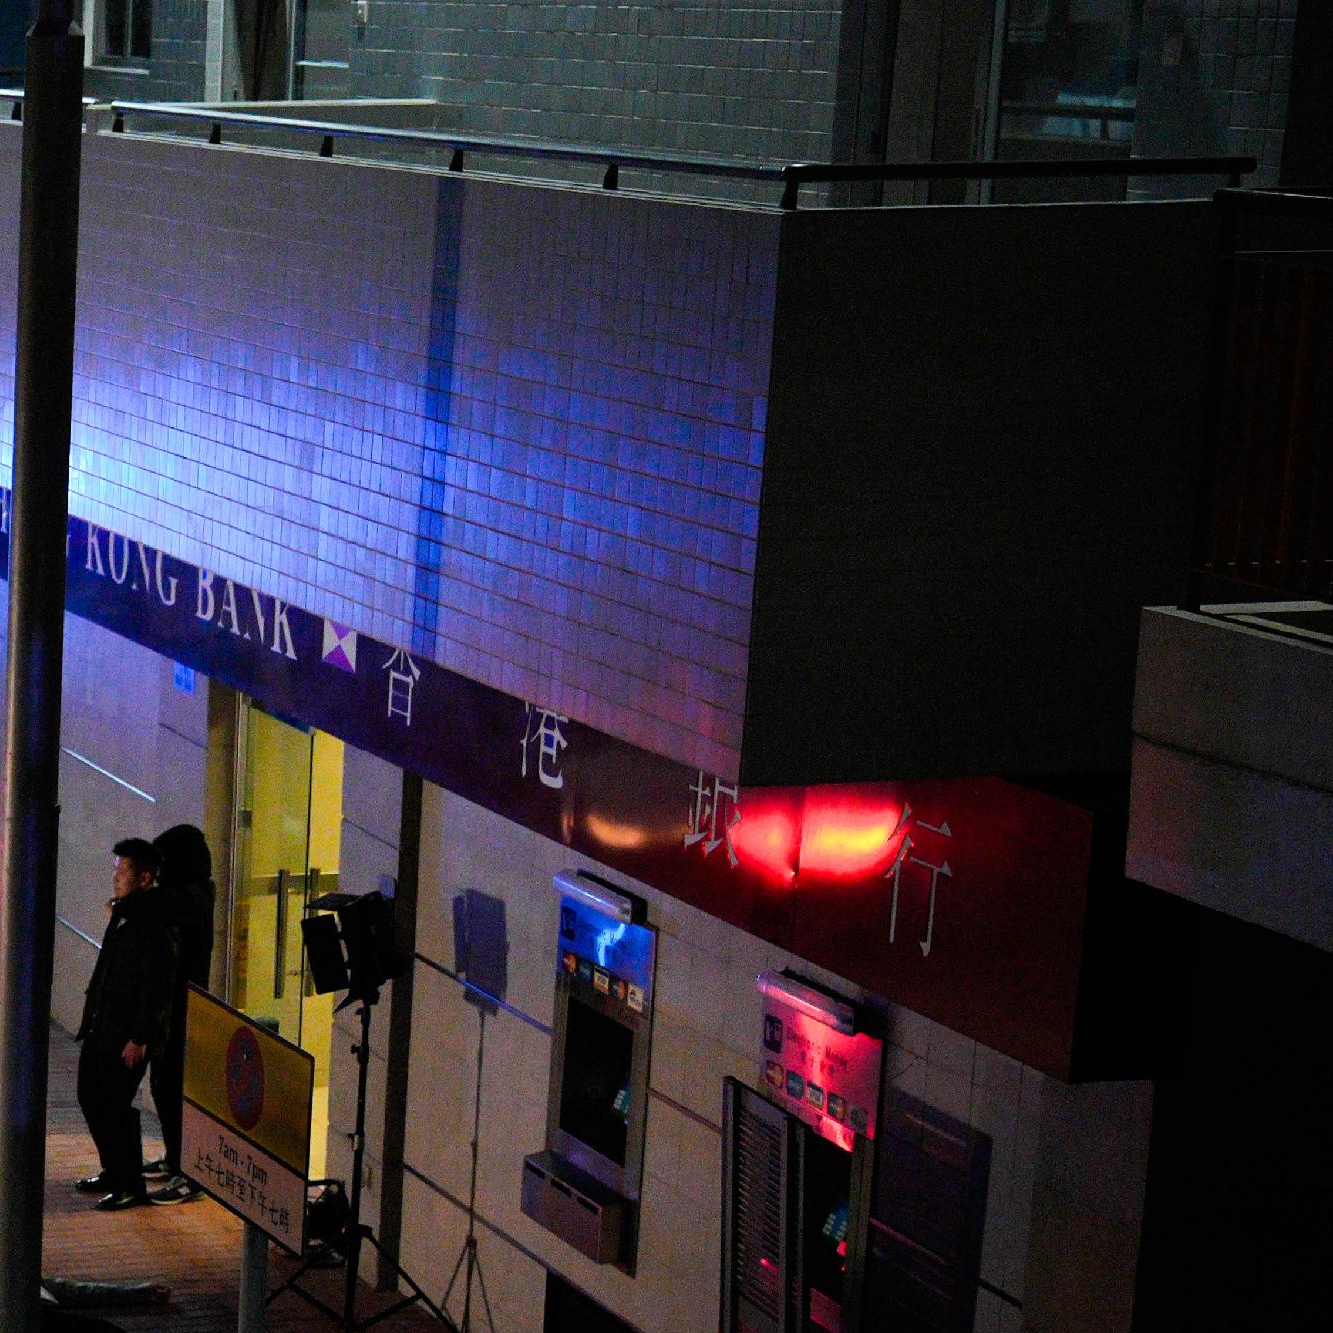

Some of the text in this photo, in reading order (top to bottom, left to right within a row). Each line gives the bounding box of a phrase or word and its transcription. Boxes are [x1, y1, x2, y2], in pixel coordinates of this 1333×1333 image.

[85, 523, 297, 660] KONG BANK
[194, 1147, 290, 1235] 上午七時至下午七時
[218, 1134, 238, 1166] 7am
[247, 1154, 268, 1186] 7pm
